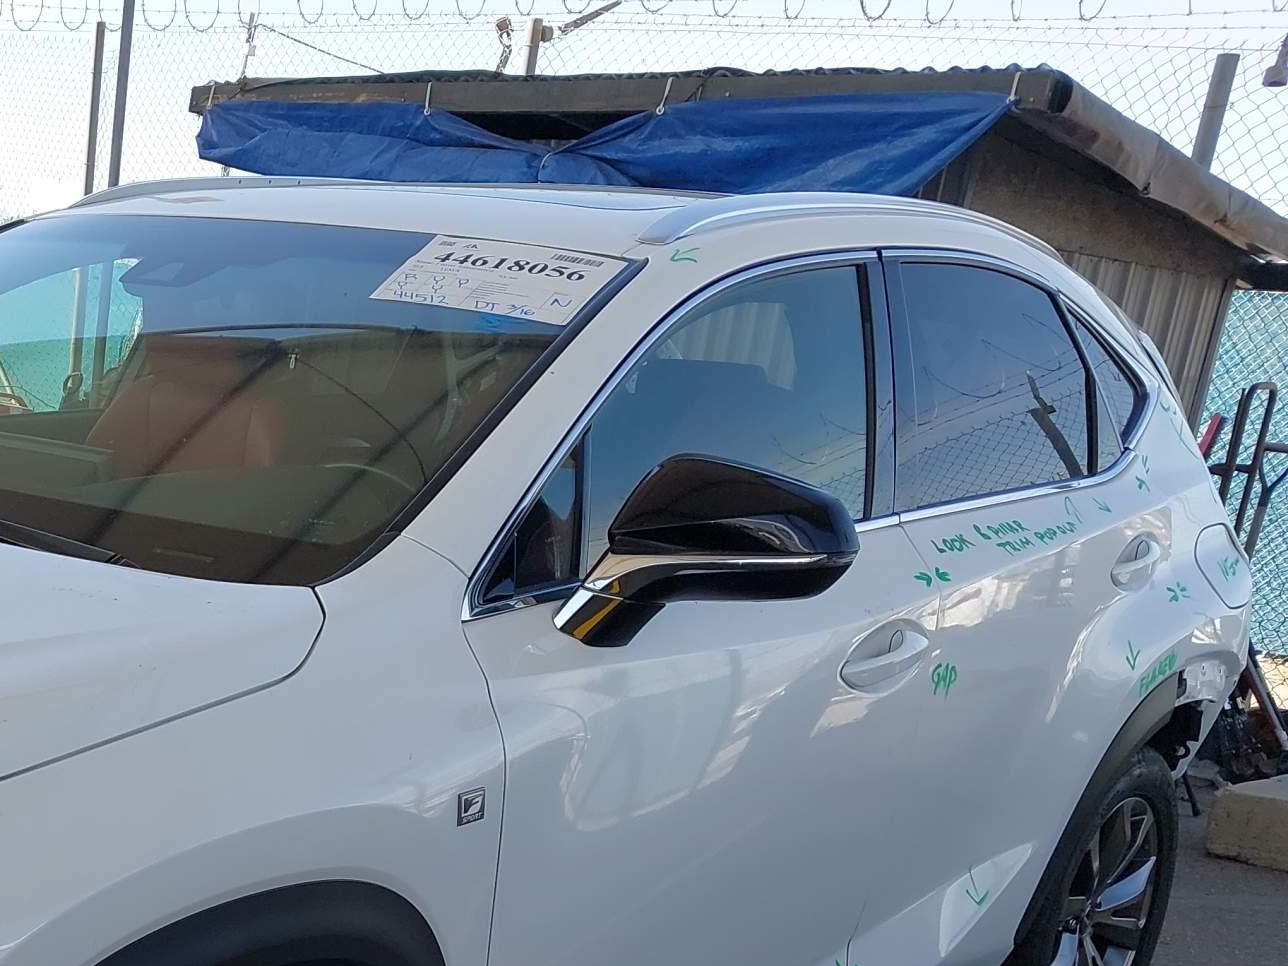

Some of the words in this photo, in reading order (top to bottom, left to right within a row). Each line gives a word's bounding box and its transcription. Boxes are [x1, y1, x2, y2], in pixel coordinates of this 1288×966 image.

[435, 251, 588, 281] 44618056
[930, 533, 976, 554] LOOK
[995, 536, 1035, 556] TRIM
